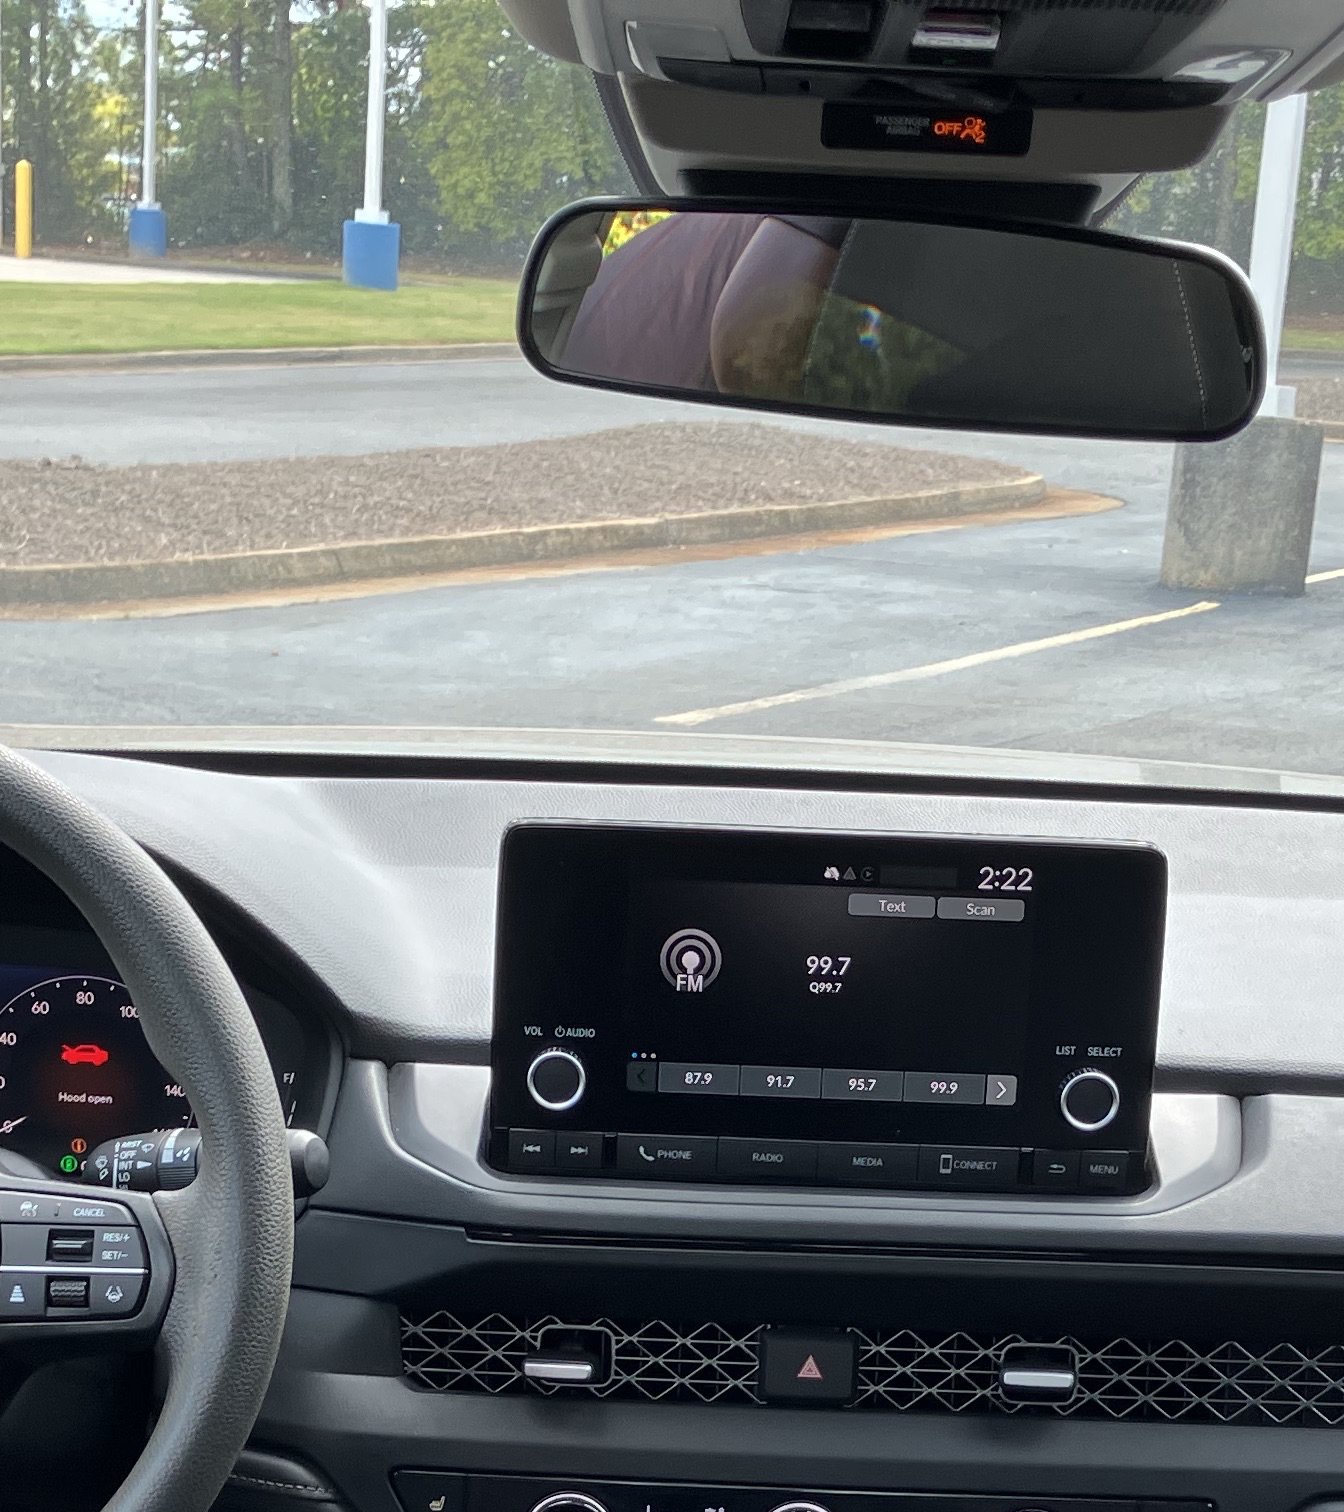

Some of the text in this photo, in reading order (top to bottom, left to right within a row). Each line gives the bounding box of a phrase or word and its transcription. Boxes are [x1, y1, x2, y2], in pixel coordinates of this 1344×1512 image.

[934, 122, 963, 135] OFF
[977, 866, 1034, 891] 2:22
[878, 900, 906, 914] Text
[965, 903, 995, 916] Scan
[806, 956, 851, 976] 99.7
[676, 974, 704, 993] FM
[809, 982, 842, 994] Q99.7
[75, 992, 95, 1005] 80
[31, 1001, 50, 1015] 60
[524, 1026, 596, 1038] VOL AUDIO
[1055, 1045, 1123, 1057] LIST SELECT
[283, 1072, 291, 1083] F
[684, 1072, 713, 1085] 87.9
[766, 1074, 795, 1088] 91.7
[848, 1078, 877, 1092] 95.7
[930, 1081, 958, 1095] 99.9
[58, 1091, 113, 1105] Hood open
[119, 1150, 137, 1159] OFF
[657, 1149, 693, 1160] PHONE
[752, 1152, 784, 1163] RADIO
[119, 1161, 134, 1171] INT
[852, 1156, 883, 1167] MEDIA
[953, 1160, 998, 1171] CONNECT
[1089, 1164, 1119, 1175] MENU
[118, 1172, 130, 1182] LO
[73, 1208, 105, 1217] CANCEL
